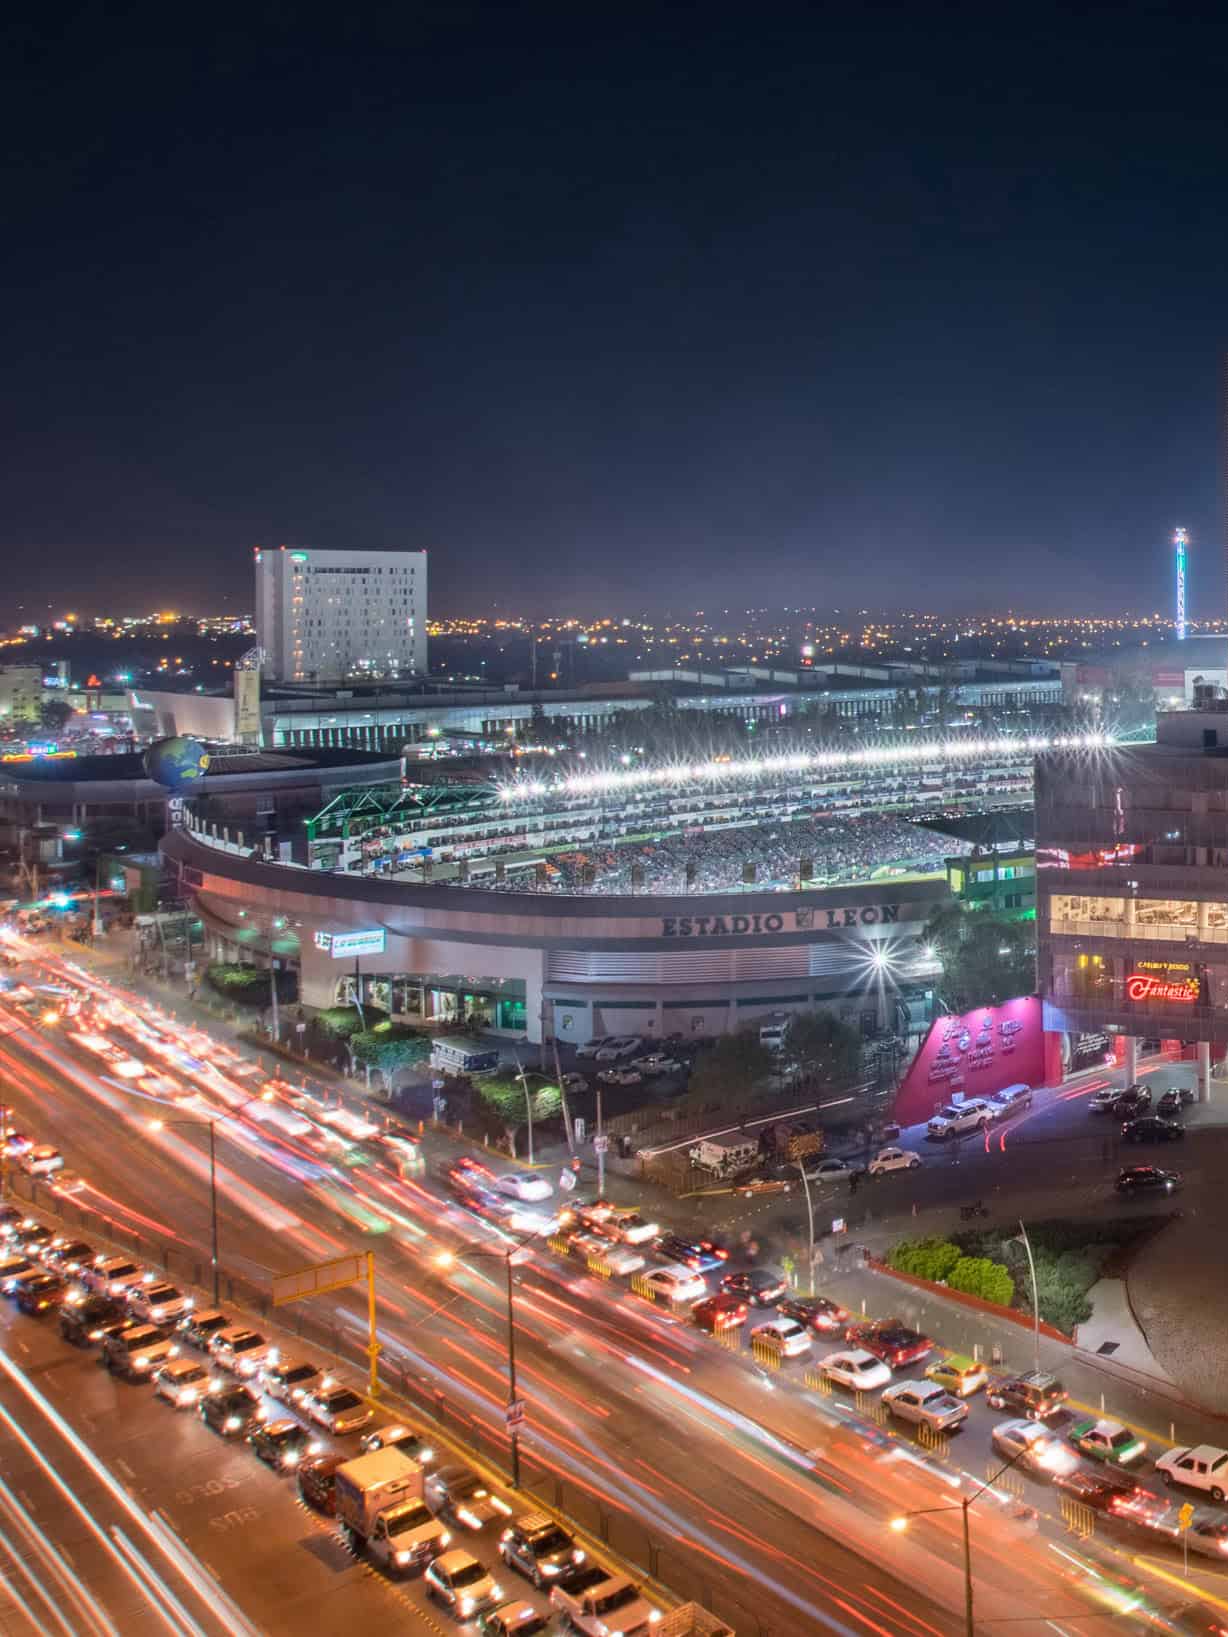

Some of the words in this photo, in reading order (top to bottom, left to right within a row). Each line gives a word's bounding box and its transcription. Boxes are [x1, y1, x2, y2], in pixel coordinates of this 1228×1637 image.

[662, 915, 784, 937] ESTADIO
[827, 904, 899, 928] LEON
[1126, 975, 1194, 1000] Fantastic
